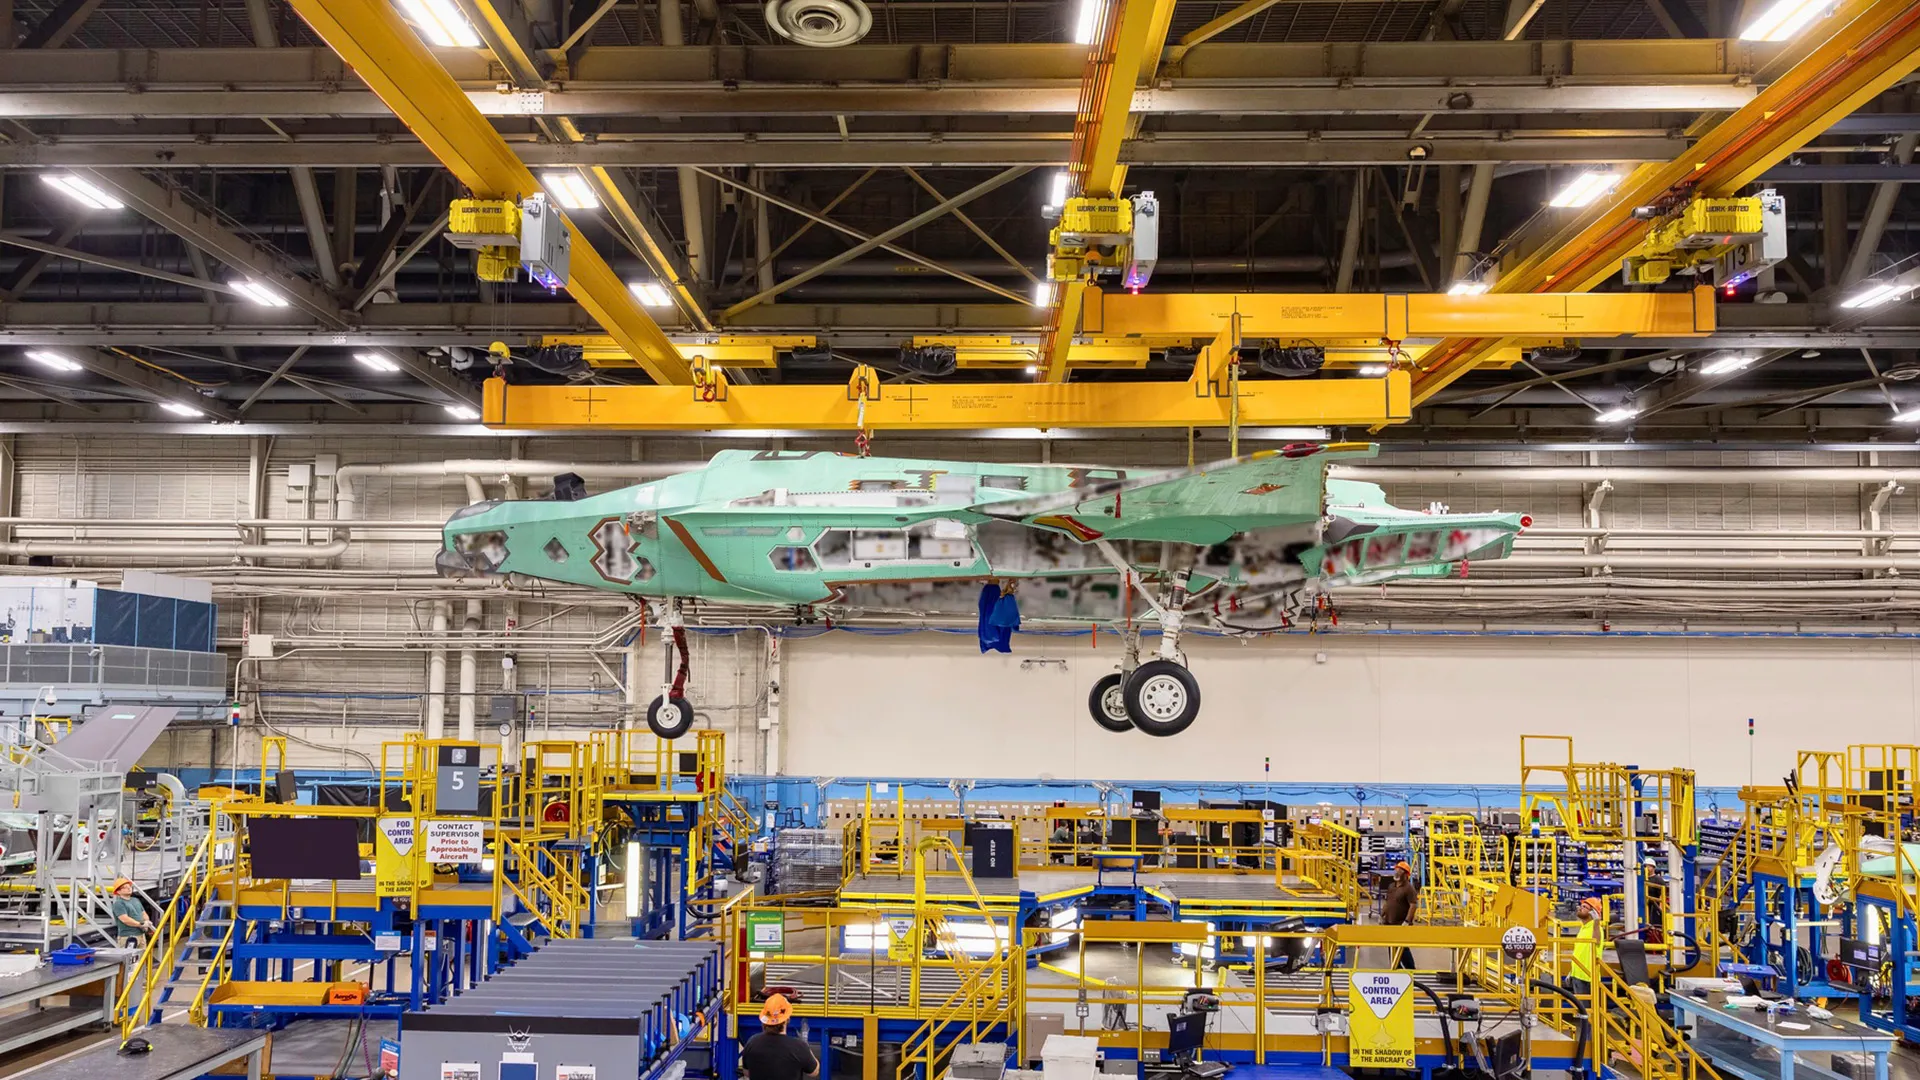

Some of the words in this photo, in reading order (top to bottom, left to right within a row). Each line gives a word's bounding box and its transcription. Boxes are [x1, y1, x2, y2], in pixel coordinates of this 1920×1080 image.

[451, 770, 464, 791] 5
[396, 820, 410, 828] FOD
[430, 846, 478, 854] Approaching
[990, 857, 996, 868] NO
[1504, 935, 1533, 943] CLEAN
[1373, 976, 1390, 984] FOD
[1362, 986, 1401, 995] CONTROL
[1370, 997, 1393, 1005] AREA
[1374, 1056, 1405, 1064] AIRCRAFT
